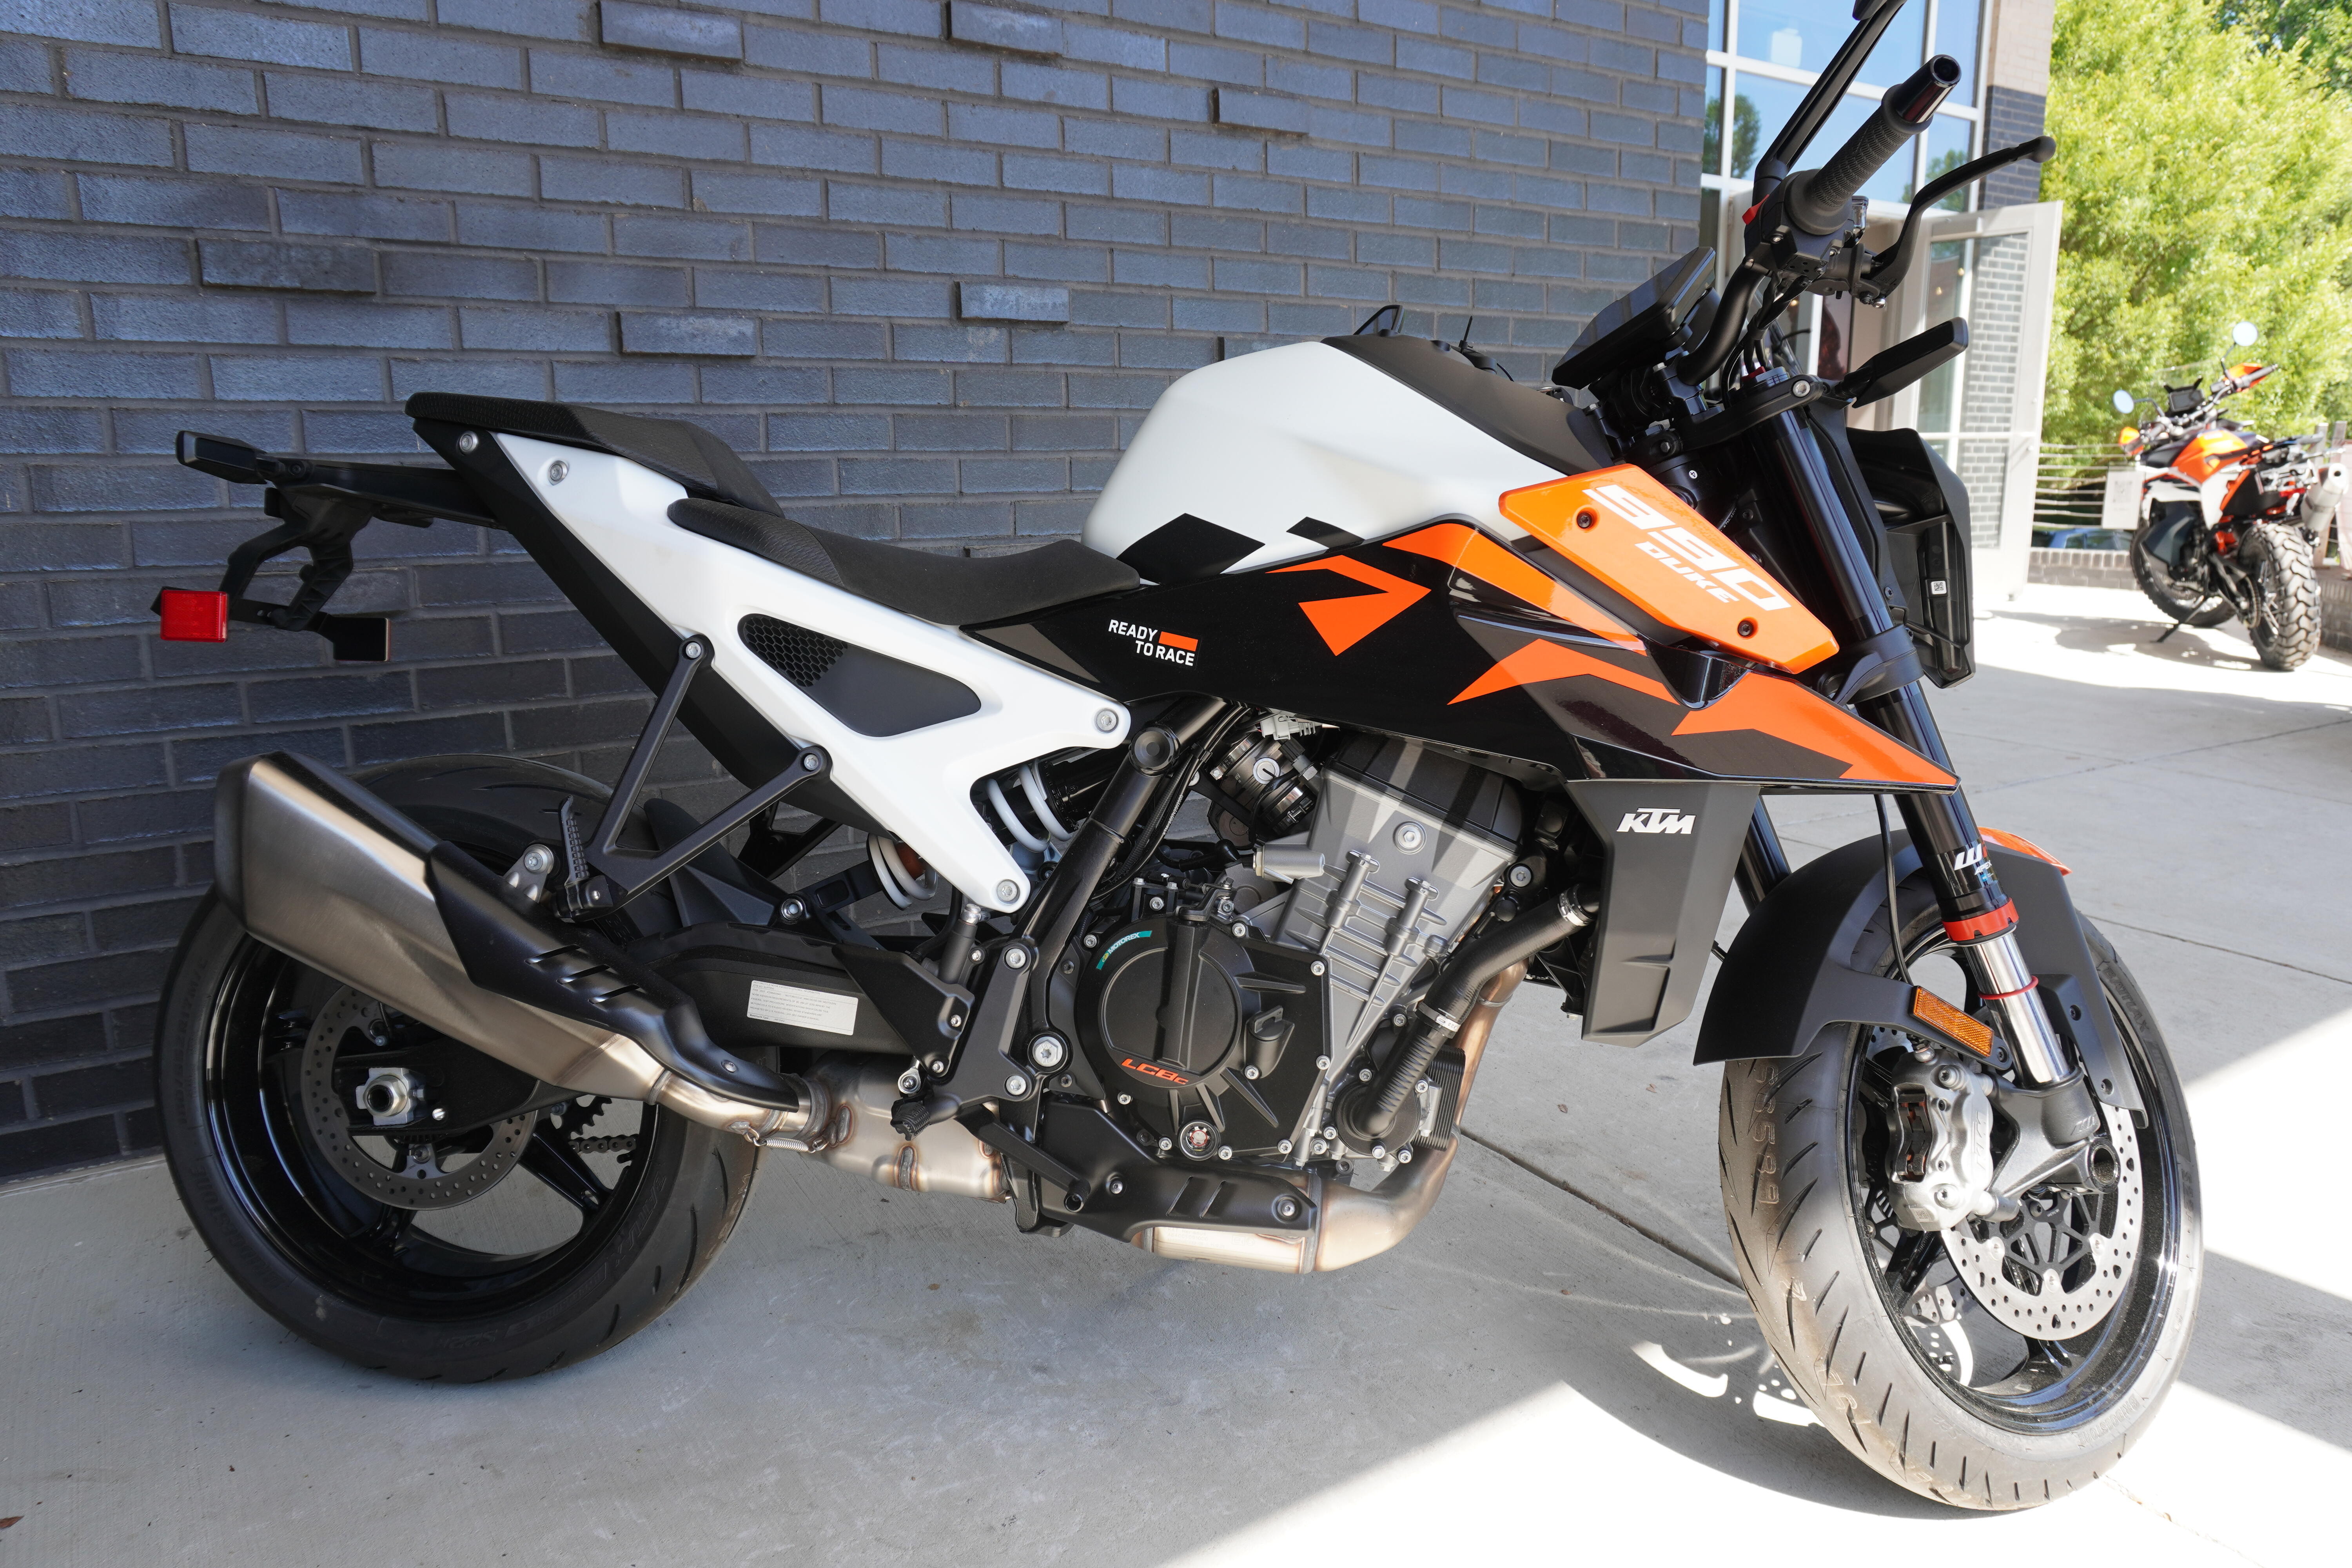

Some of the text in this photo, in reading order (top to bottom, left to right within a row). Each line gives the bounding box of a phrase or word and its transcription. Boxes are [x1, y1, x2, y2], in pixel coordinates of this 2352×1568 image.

[1582, 485, 1791, 611] 990
[1635, 541, 1739, 603] DUKE
[1108, 619, 1158, 641] READY
[1135, 640, 1195, 666] TO RACE
[1616, 808, 1696, 834] KTM
[1974, 860, 1992, 875] APEX
[1108, 932, 1140, 955] MOTOREX
